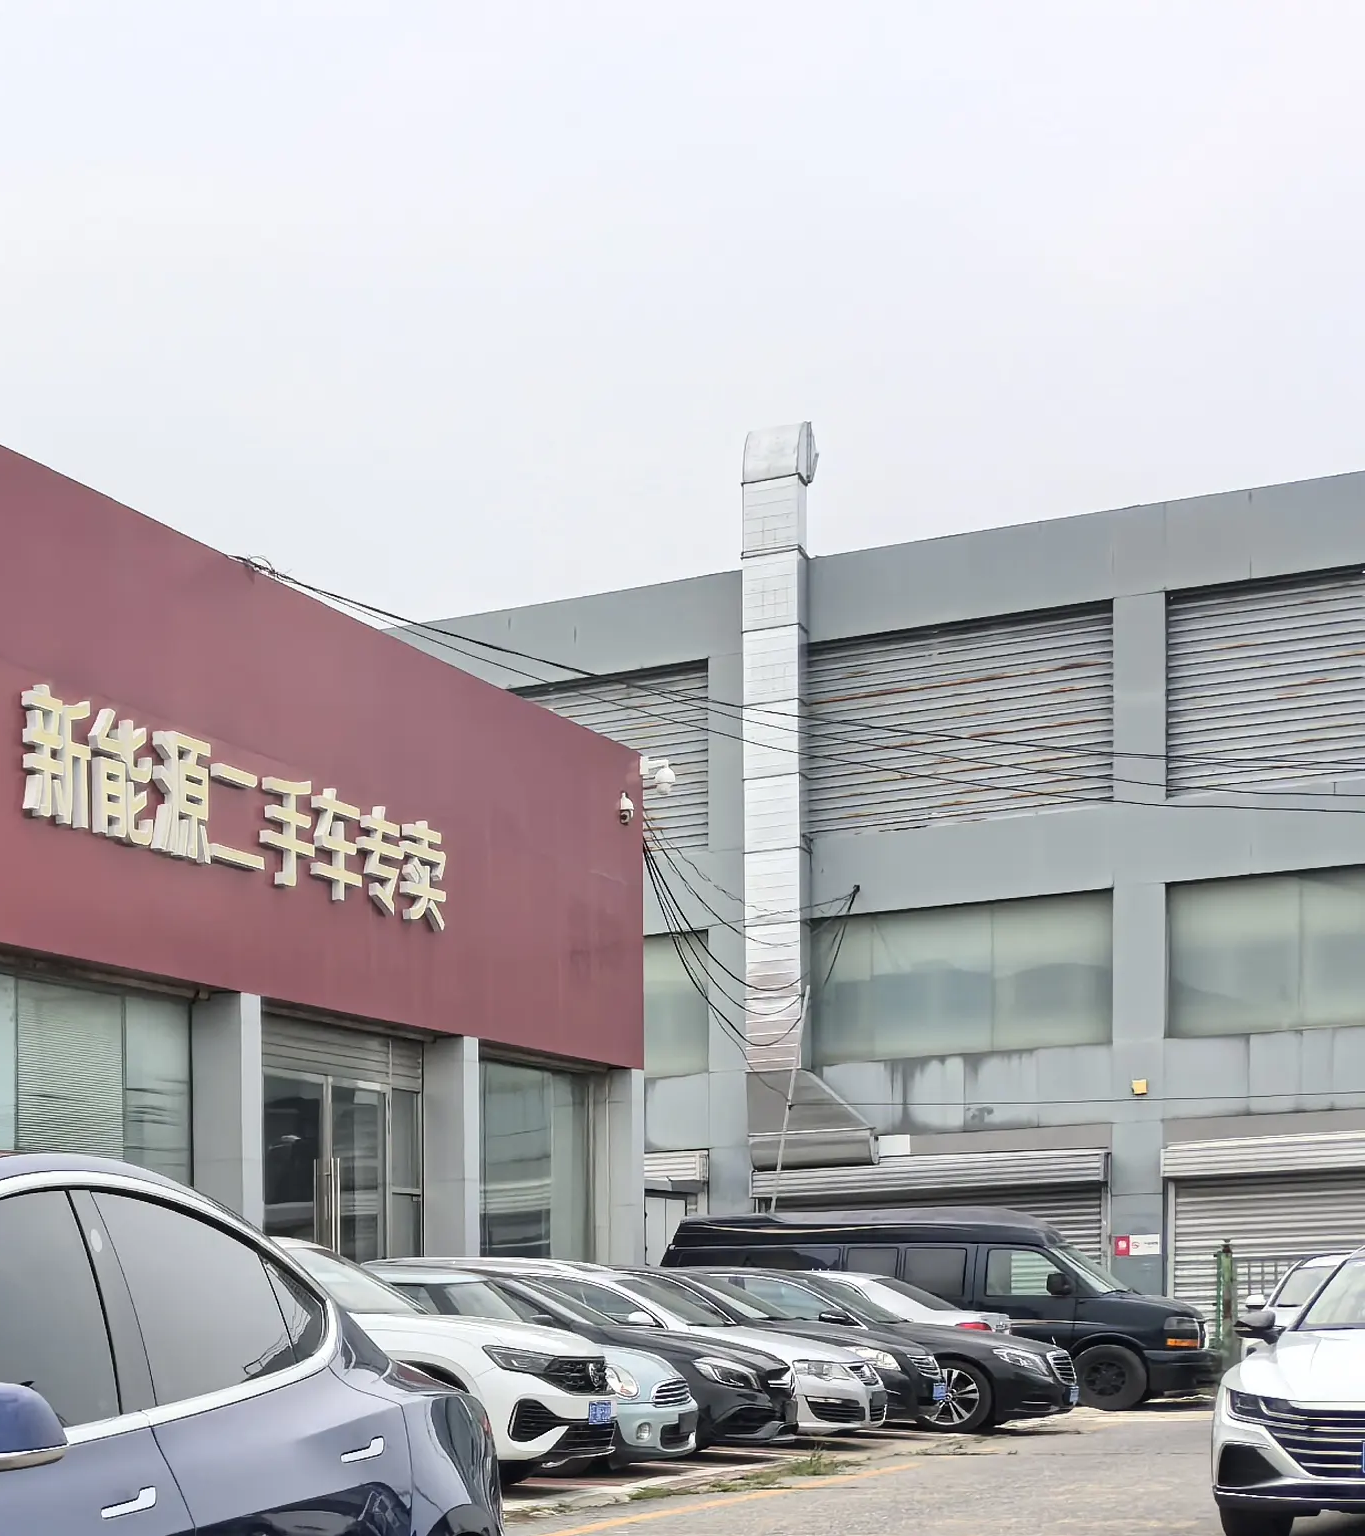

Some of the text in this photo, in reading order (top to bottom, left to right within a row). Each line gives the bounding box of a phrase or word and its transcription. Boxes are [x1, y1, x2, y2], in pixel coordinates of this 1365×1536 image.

[21, 684, 446, 931] 新能源二手车专卖
